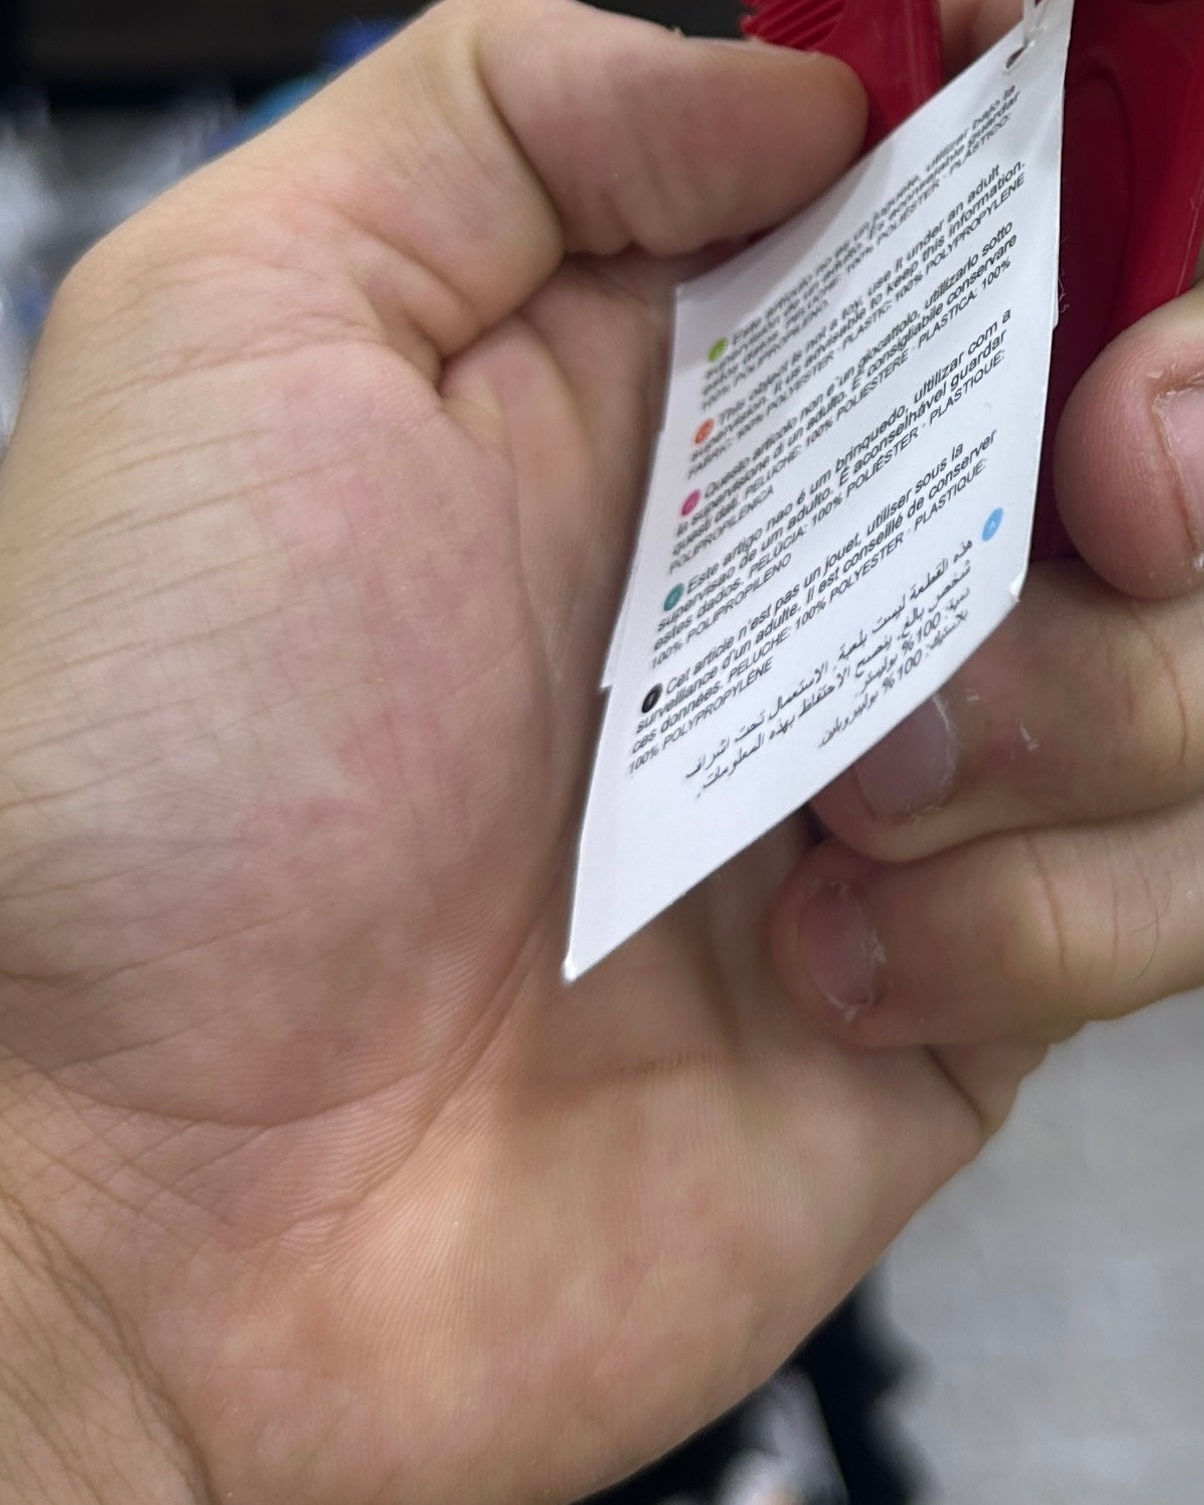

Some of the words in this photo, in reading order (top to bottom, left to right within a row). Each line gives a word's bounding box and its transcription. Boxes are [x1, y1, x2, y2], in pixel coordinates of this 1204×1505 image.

[799, 393, 824, 421] non
[981, 221, 1013, 257] sotto
[867, 269, 892, 297] use
[894, 256, 903, 273] it
[906, 218, 945, 261] under
[946, 201, 964, 224] an
[967, 164, 1000, 204] adult
[869, 292, 883, 310] to
[885, 260, 919, 295] keep
[921, 234, 945, 263] this
[948, 161, 1025, 238] information.
[894, 272, 924, 302] 100%
[925, 172, 1024, 275] POLYPROPYLENE
[786, 426, 804, 448] un
[866, 302, 944, 378] consigliabile
[946, 234, 1017, 306] conservare
[805, 418, 834, 447] 100%
[835, 347, 909, 421] POLIESTERE
[981, 257, 1011, 290] 100%
[653, 614, 693, 652] estes
[811, 492, 843, 526] 100%
[845, 425, 919, 498] POLIÉSTER
[929, 349, 1002, 425] PLASTIQUE:
[686, 562, 720, 595] Este
[721, 527, 763, 567] artigo
[796, 490, 806, 506] é
[809, 468, 832, 496] um
[834, 404, 909, 474] brinquedo,
[967, 320, 998, 356] com
[1001, 308, 1011, 324] a
[738, 548, 758, 570] de
[760, 526, 784, 552] um
[786, 486, 831, 531] adulto.
[852, 380, 947, 475] aconselhável
[949, 329, 1006, 392] guardar
[631, 728, 657, 754] ces
[795, 597, 827, 630] 100%
[828, 531, 904, 603] POLYESTER
[635, 665, 718, 734] surveillance
[720, 639, 752, 670] d'un
[754, 602, 801, 645] adulte.
[805, 584, 815, 605] Il
[817, 565, 840, 594] est
[842, 512, 904, 574] conseillé
[906, 496, 925, 519] de
[927, 429, 996, 500] conserver
[651, 640, 683, 669] 100%
[686, 552, 792, 644] POLIPROPILENO
[665, 667, 691, 696] Cet
[692, 635, 735, 676] article
[773, 583, 800, 617] pas
[803, 566, 821, 589] un
[822, 532, 862, 578] jouet,
[866, 487, 913, 536] utiliser
[914, 457, 947, 494] sous
[950, 442, 964, 462] la
[871, 593, 906, 634] ليست
[909, 558, 949, 601] القطعة
[629, 745, 660, 774] 100%
[734, 716, 765, 743] تحت
